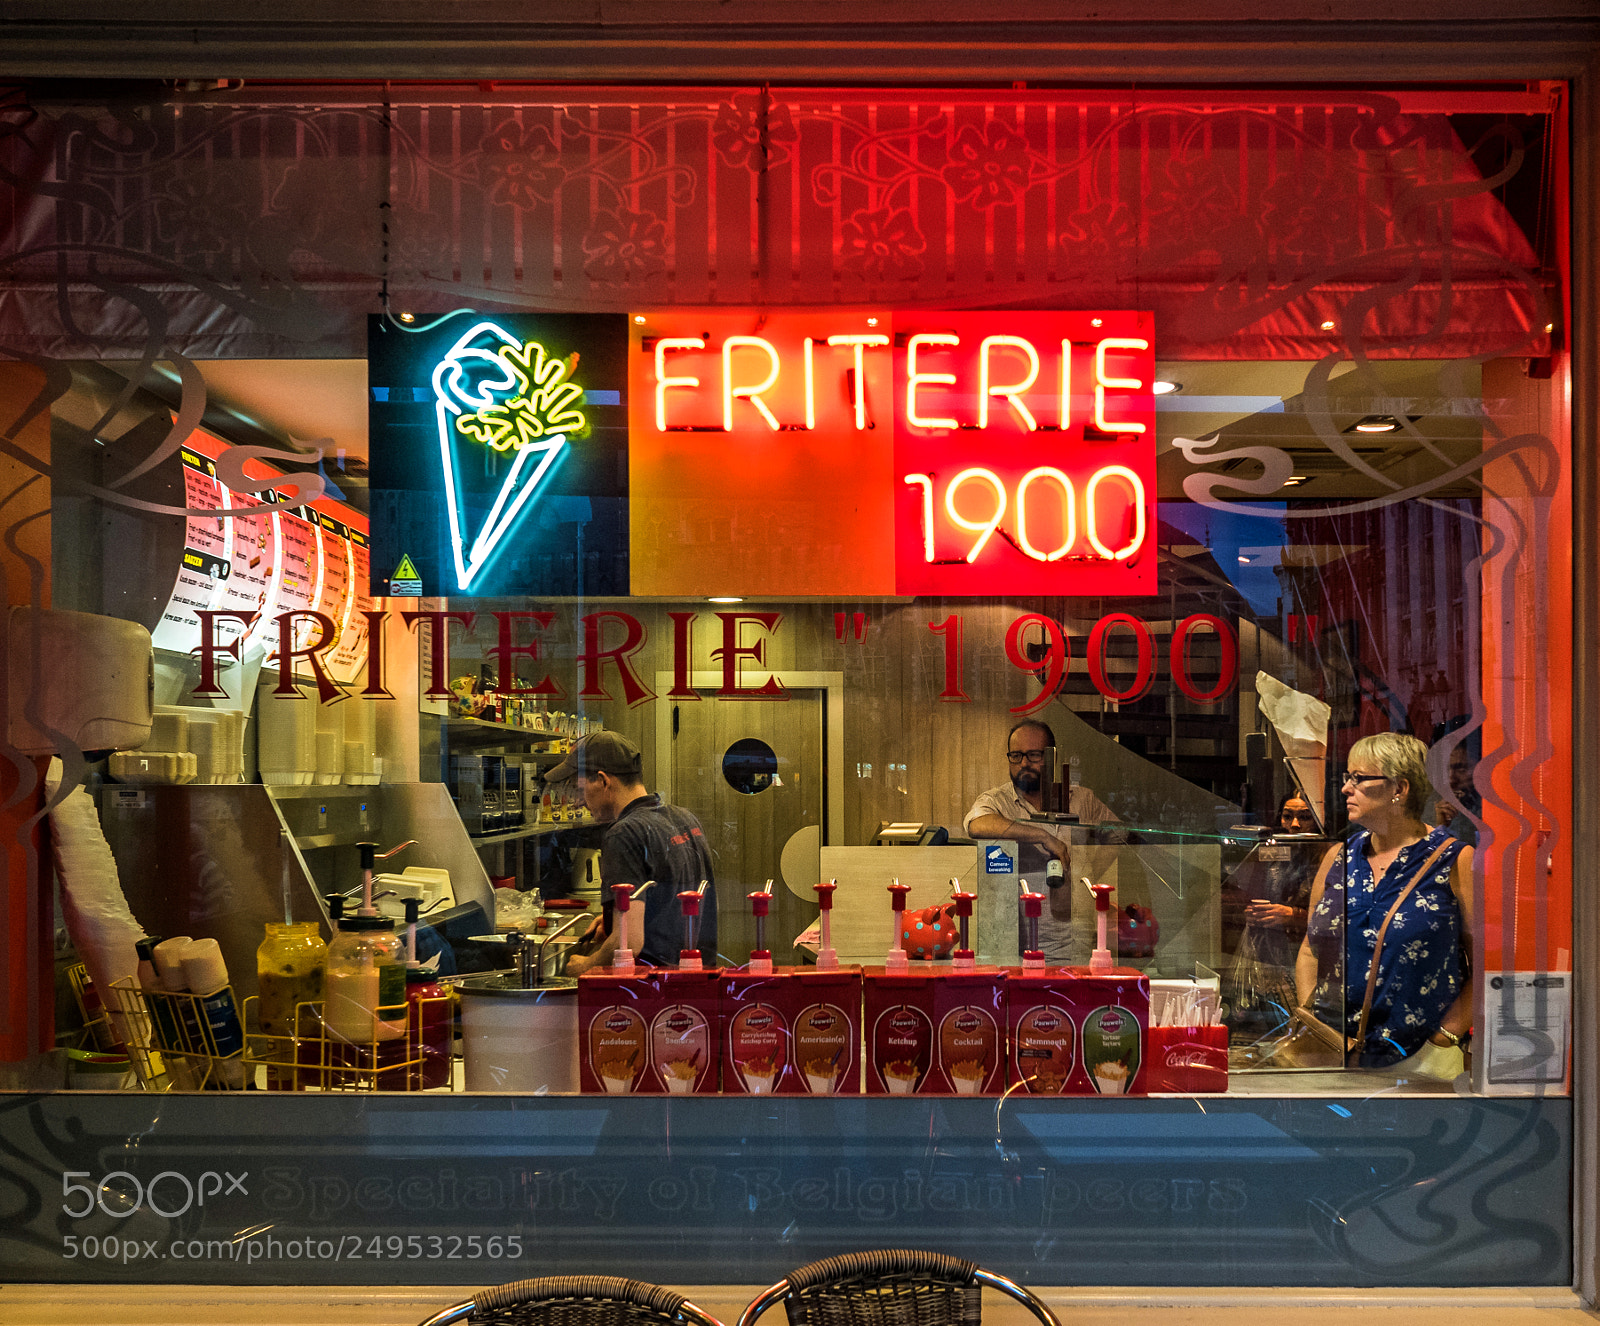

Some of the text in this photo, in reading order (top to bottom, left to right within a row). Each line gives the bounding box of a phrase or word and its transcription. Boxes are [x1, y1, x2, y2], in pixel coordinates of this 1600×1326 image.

[654, 333, 1149, 434] FRITERIE
[903, 464, 1146, 564] 1900
[191, 609, 791, 709] FRITERIE
[928, 611, 1241, 718] 1900
[600, 1037, 637, 1046] Andalouse
[800, 1035, 845, 1044] Americain(e)
[888, 1037, 918, 1047] Ketchup
[953, 1037, 983, 1046] Cocktail
[1025, 1037, 1067, 1046] Mammouth
[261, 1166, 627, 1220] Speciality
[648, 1165, 718, 1211] of
[731, 1167, 1017, 1221] Belgian
